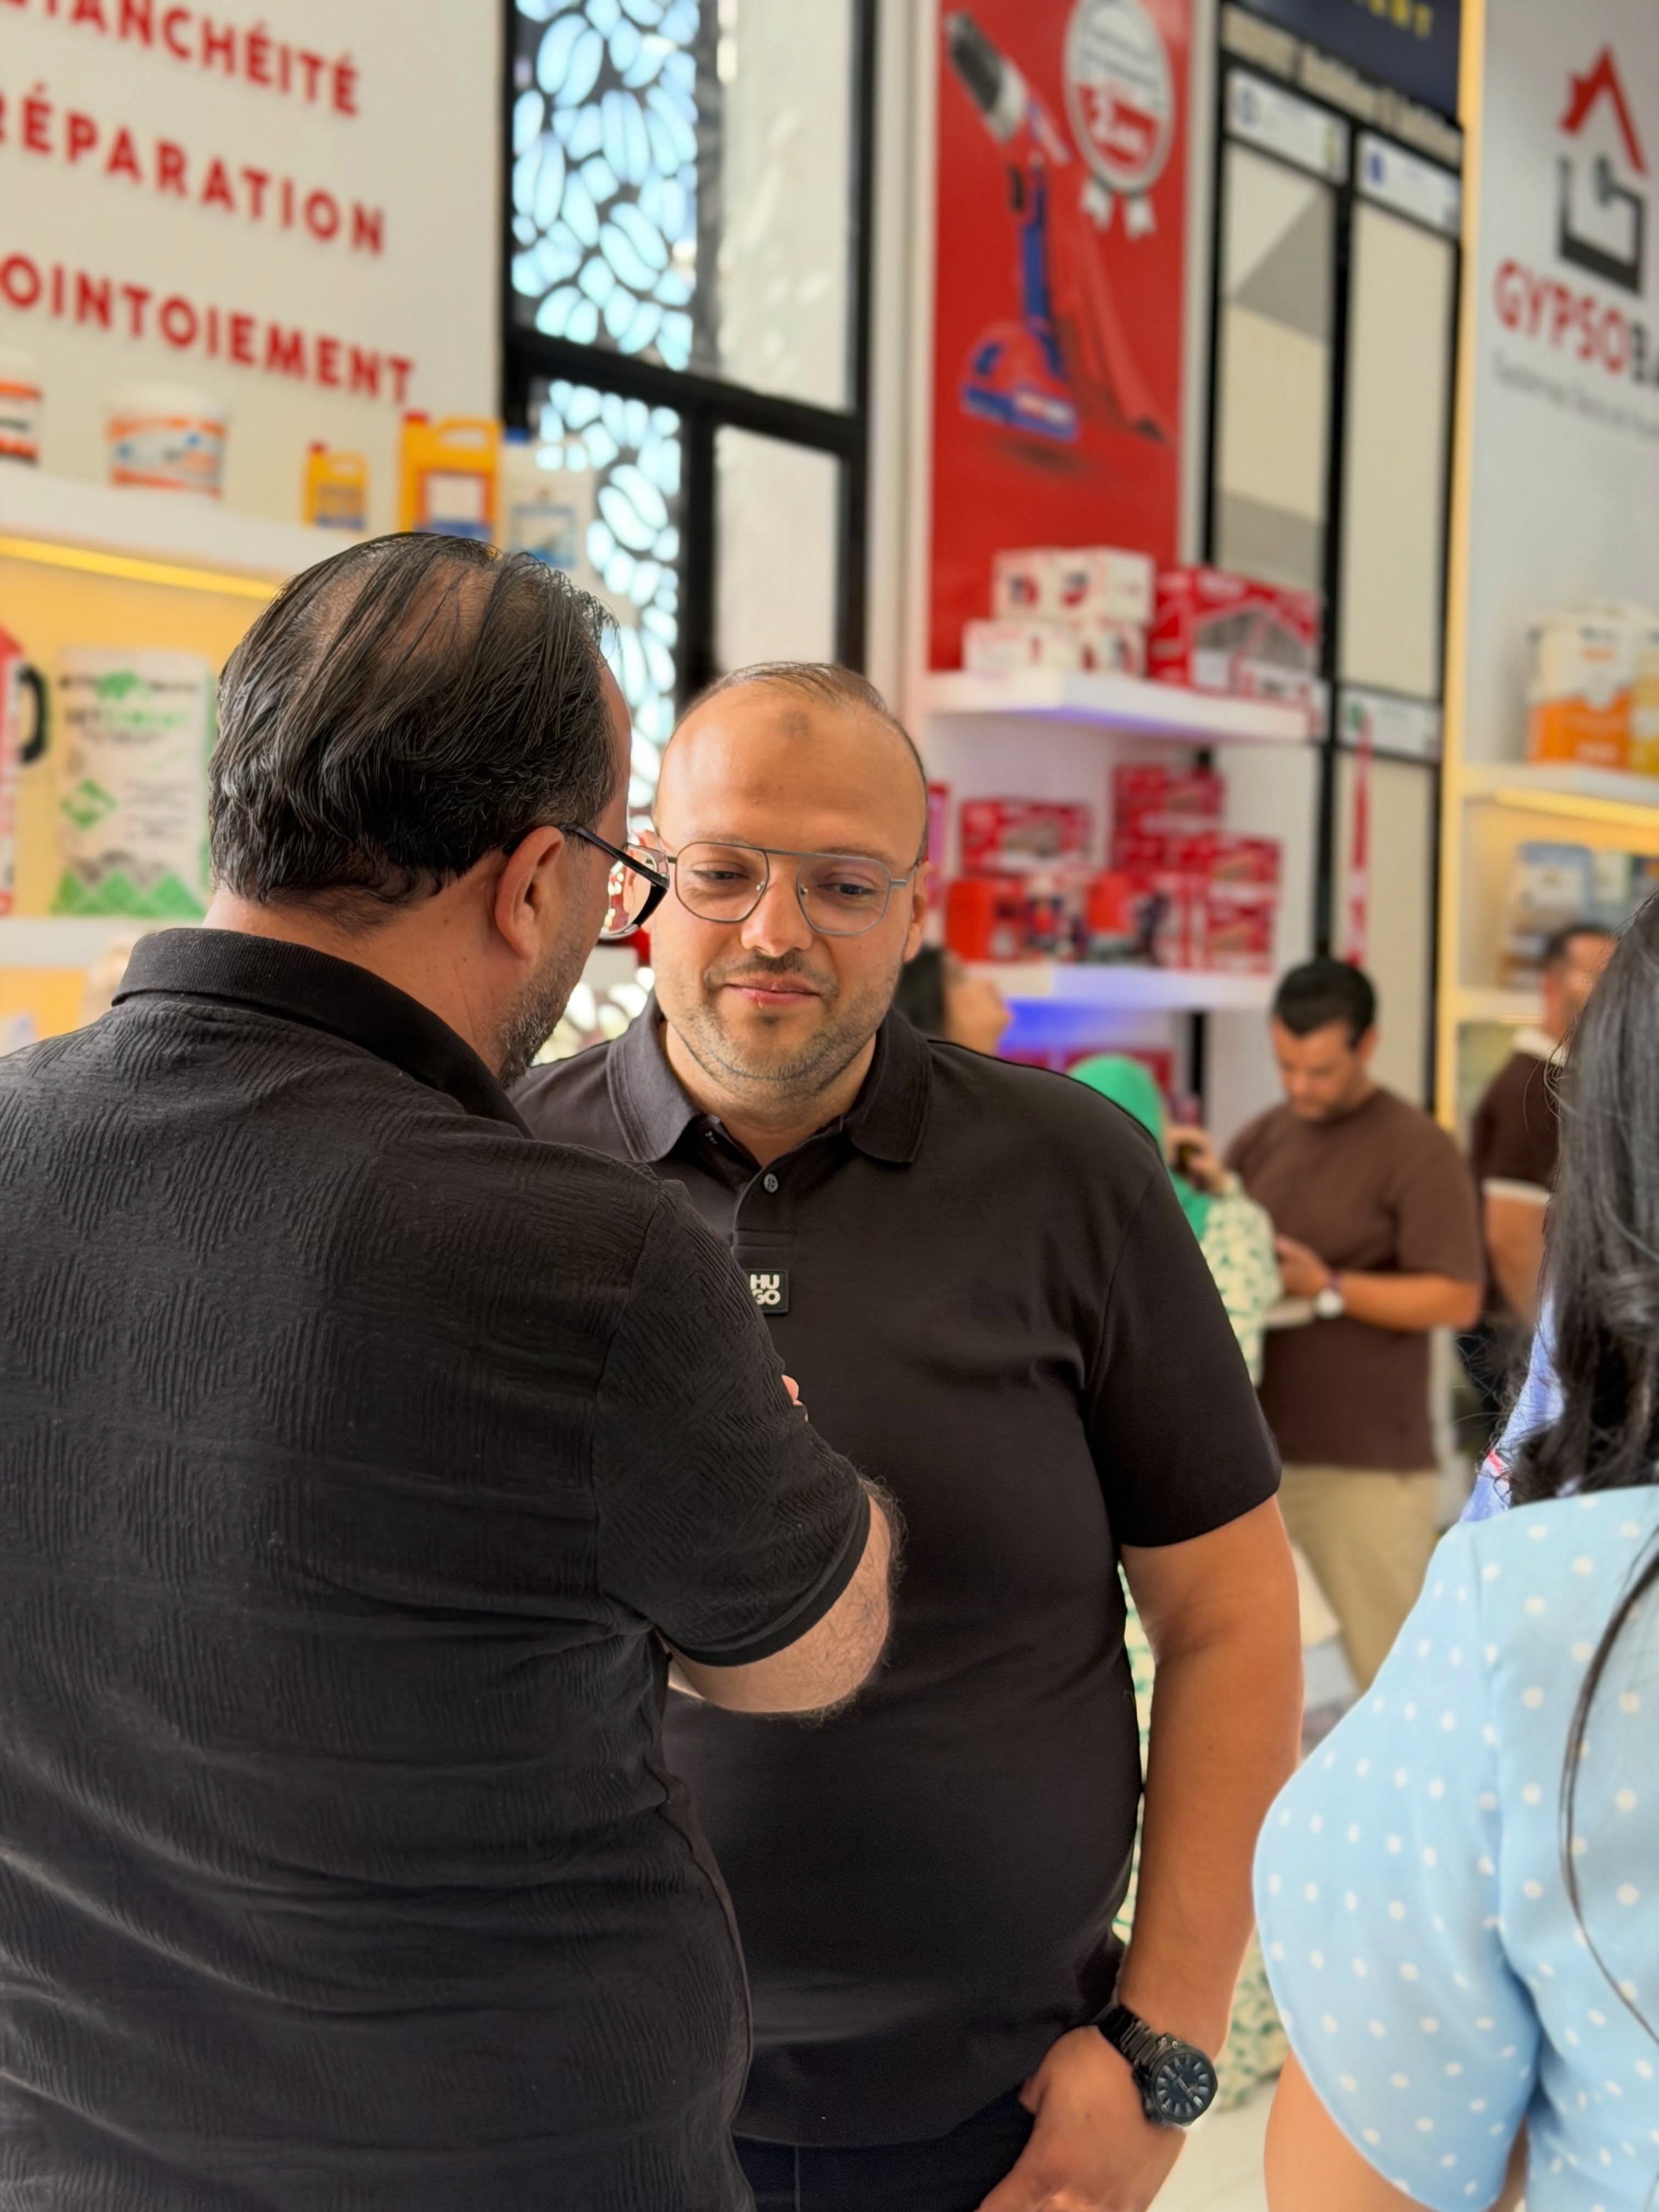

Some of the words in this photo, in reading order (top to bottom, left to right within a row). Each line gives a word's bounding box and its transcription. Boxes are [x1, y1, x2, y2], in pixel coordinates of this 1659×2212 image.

[0, 0, 360, 116] ANCHÉITÉ
[0, 80, 385, 258] ÉPARATION
[0, 252, 415, 406] OINTOIEMENT
